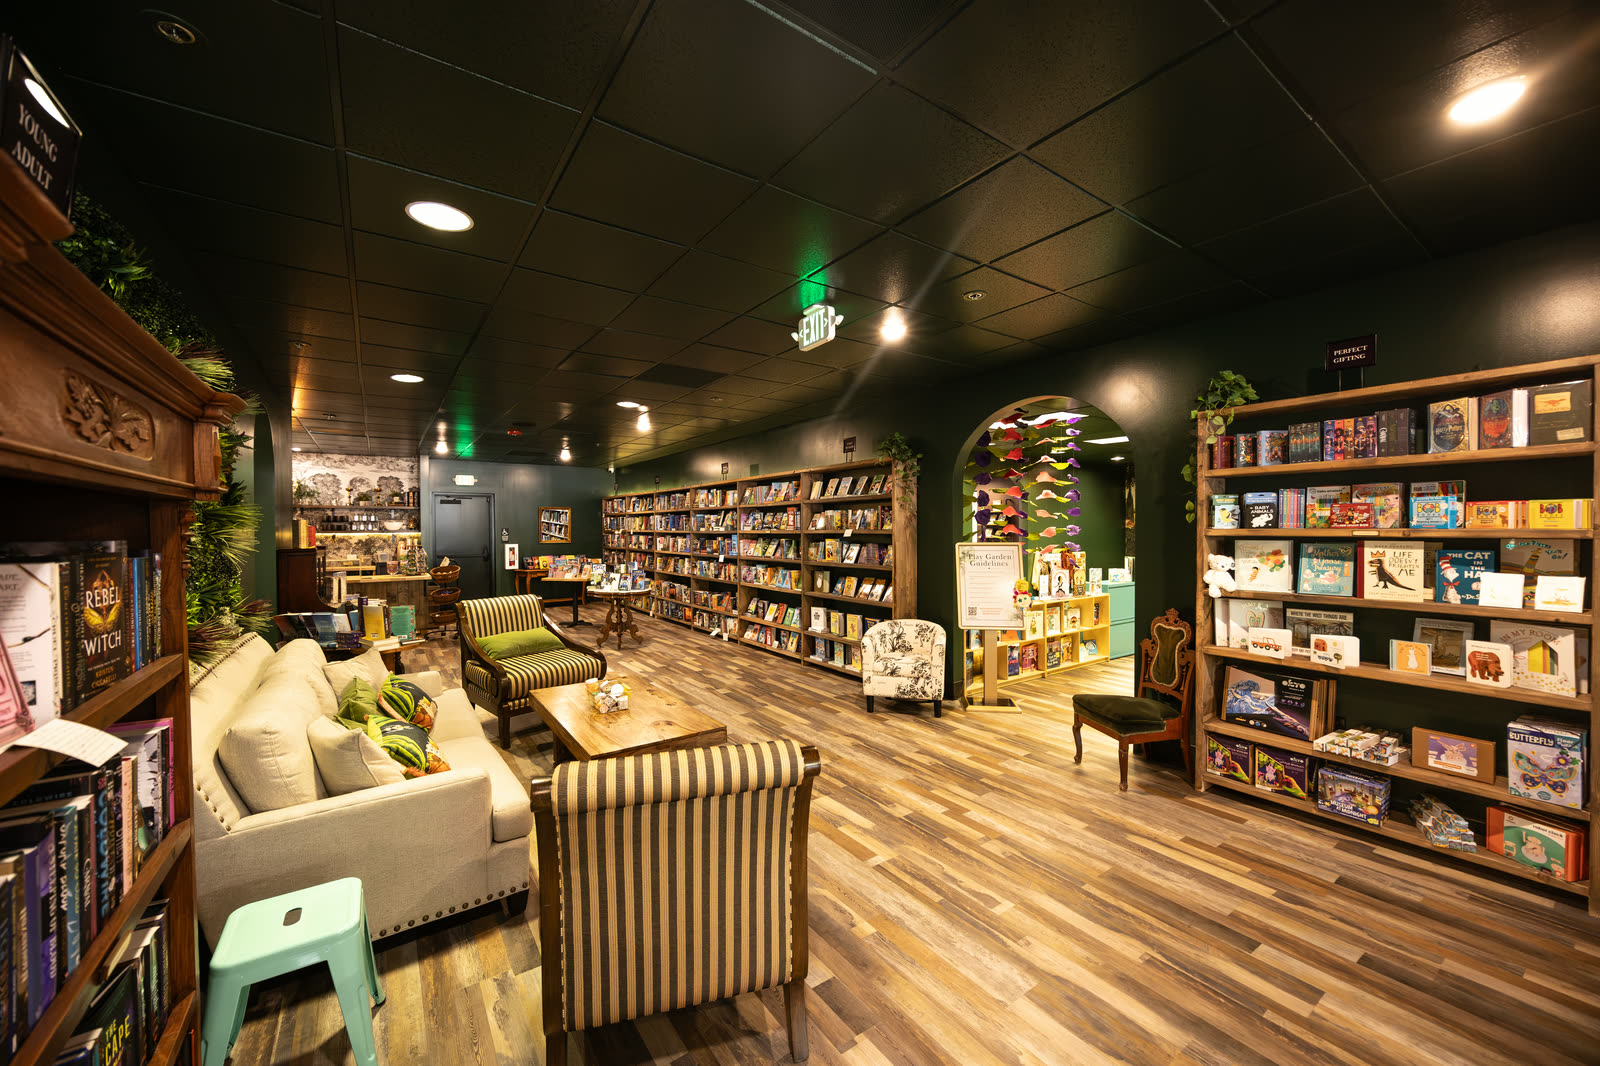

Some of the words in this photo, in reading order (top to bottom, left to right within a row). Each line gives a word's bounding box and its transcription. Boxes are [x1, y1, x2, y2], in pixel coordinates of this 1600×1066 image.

[19, 103, 58, 163] YOUNG
[12, 140, 53, 190] ADULT
[802, 307, 826, 347] EXIT
[1333, 344, 1368, 356] PERFECT
[1333, 353, 1366, 364] GIFTING
[968, 553, 984, 561] Play
[1464, 551, 1491, 560] CAT
[1398, 568, 1415, 576] ME
[1463, 570, 1481, 579] HA
[85, 586, 121, 609] REBEL
[84, 629, 122, 657] WITCH
[1499, 633, 1511, 643] IN
[1511, 629, 1526, 638] MY
[1509, 731, 1555, 747] BUTTERFLY
[105, 1018, 117, 1042] THE
